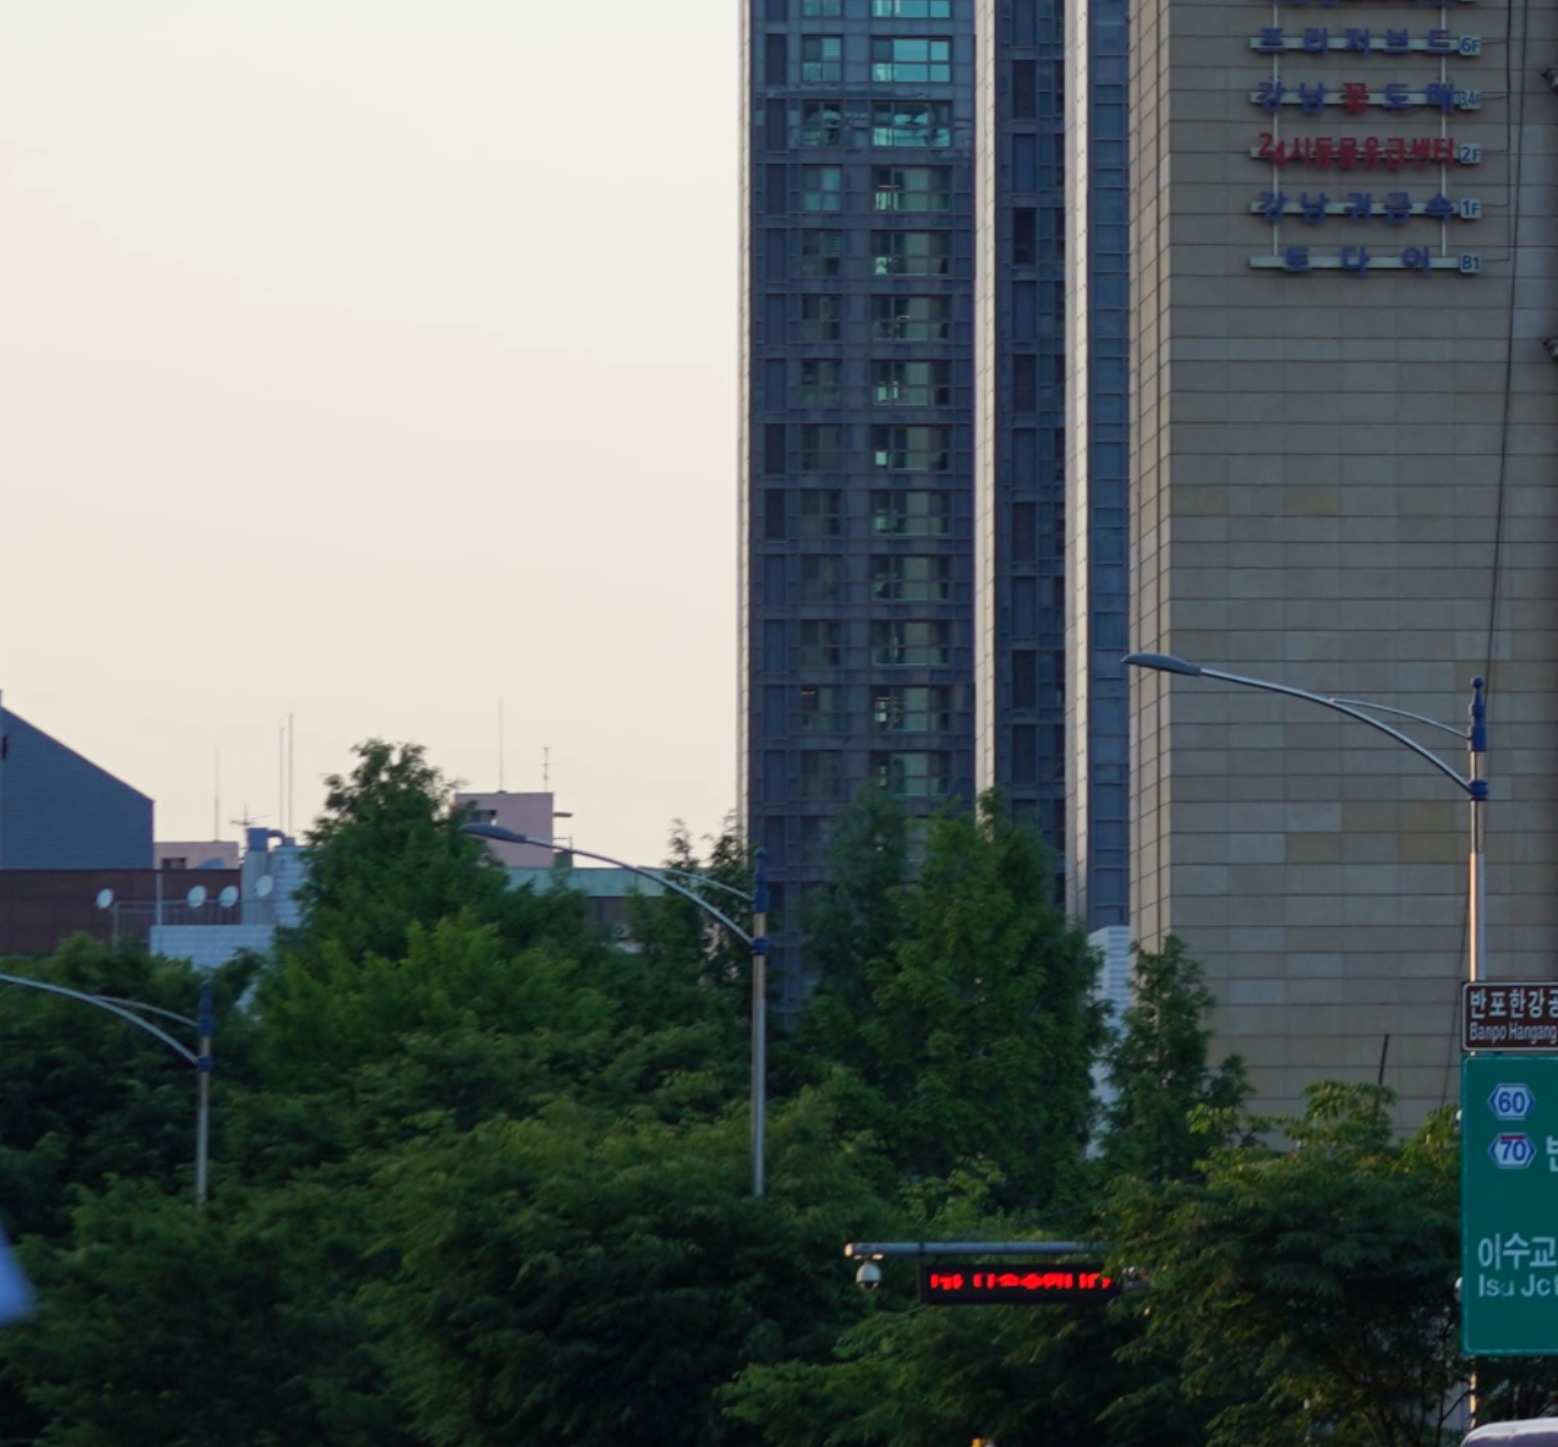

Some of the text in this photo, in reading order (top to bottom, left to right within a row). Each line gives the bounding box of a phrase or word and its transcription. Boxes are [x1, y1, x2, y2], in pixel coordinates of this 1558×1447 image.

[1461, 36, 1481, 52] 6F
[1461, 146, 1480, 162] 2F
[1462, 201, 1480, 217] 1F
[1283, 247, 1480, 278] 토다이 B1
[1470, 1022, 1507, 1043] Banpo
[1509, 1022, 1557, 1044] Hangang
[1498, 1091, 1526, 1113] 60
[1500, 1141, 1526, 1161] 70
